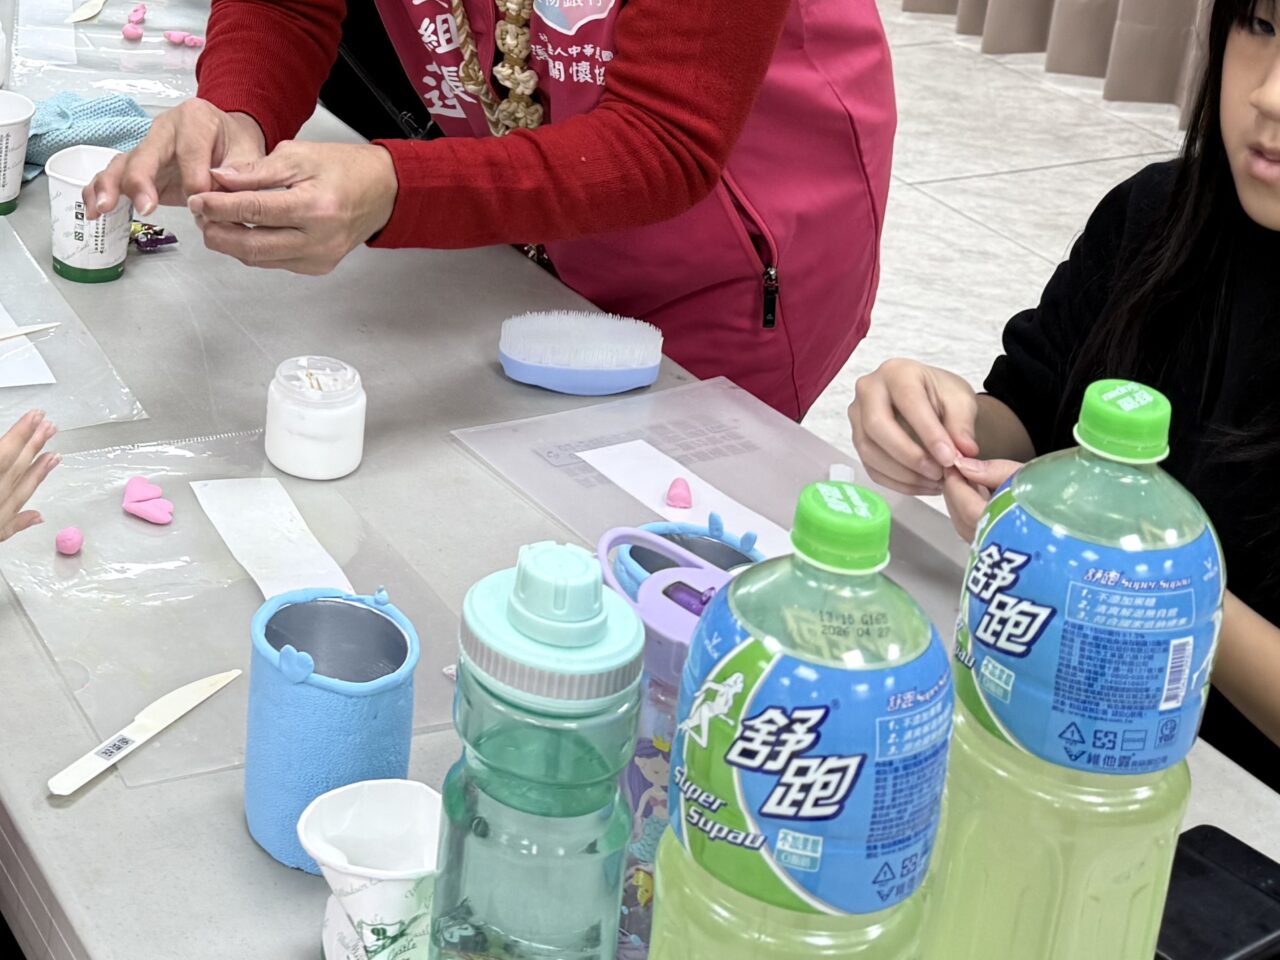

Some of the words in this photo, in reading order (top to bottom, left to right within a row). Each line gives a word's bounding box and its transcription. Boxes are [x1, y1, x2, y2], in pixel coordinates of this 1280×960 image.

[967, 542, 1057, 657] 舒跑
[674, 766, 727, 813] Super
[724, 704, 867, 821] 舒跑
[686, 805, 767, 851] Supau
